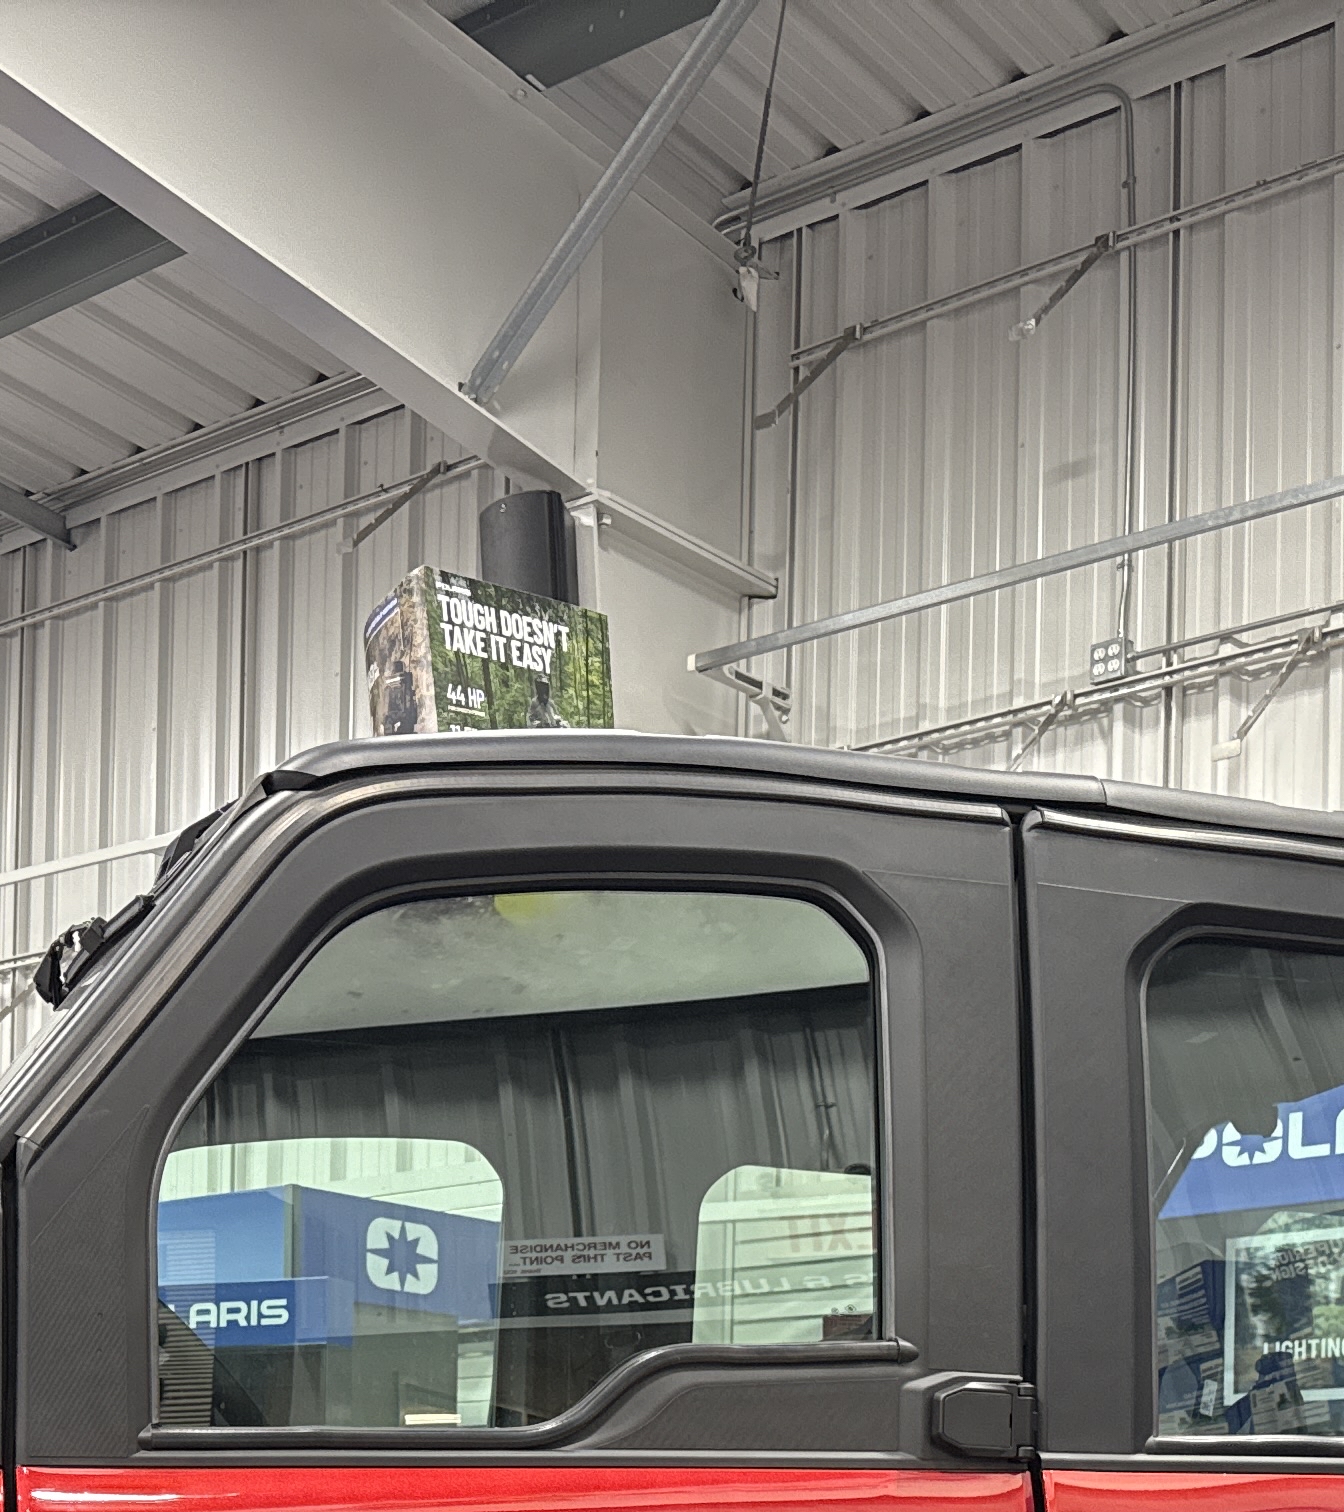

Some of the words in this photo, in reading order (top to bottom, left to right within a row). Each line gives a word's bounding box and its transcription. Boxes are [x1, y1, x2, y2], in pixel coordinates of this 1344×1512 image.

[437, 594, 498, 633] TOUGH
[500, 609, 569, 652] DOESN'T
[440, 623, 488, 659] TAKE
[489, 635, 506, 663] IT
[511, 639, 552, 674] EASY
[447, 683, 465, 705] 44
[467, 686, 485, 709] HP
[168, 1299, 289, 1329] ARIS
